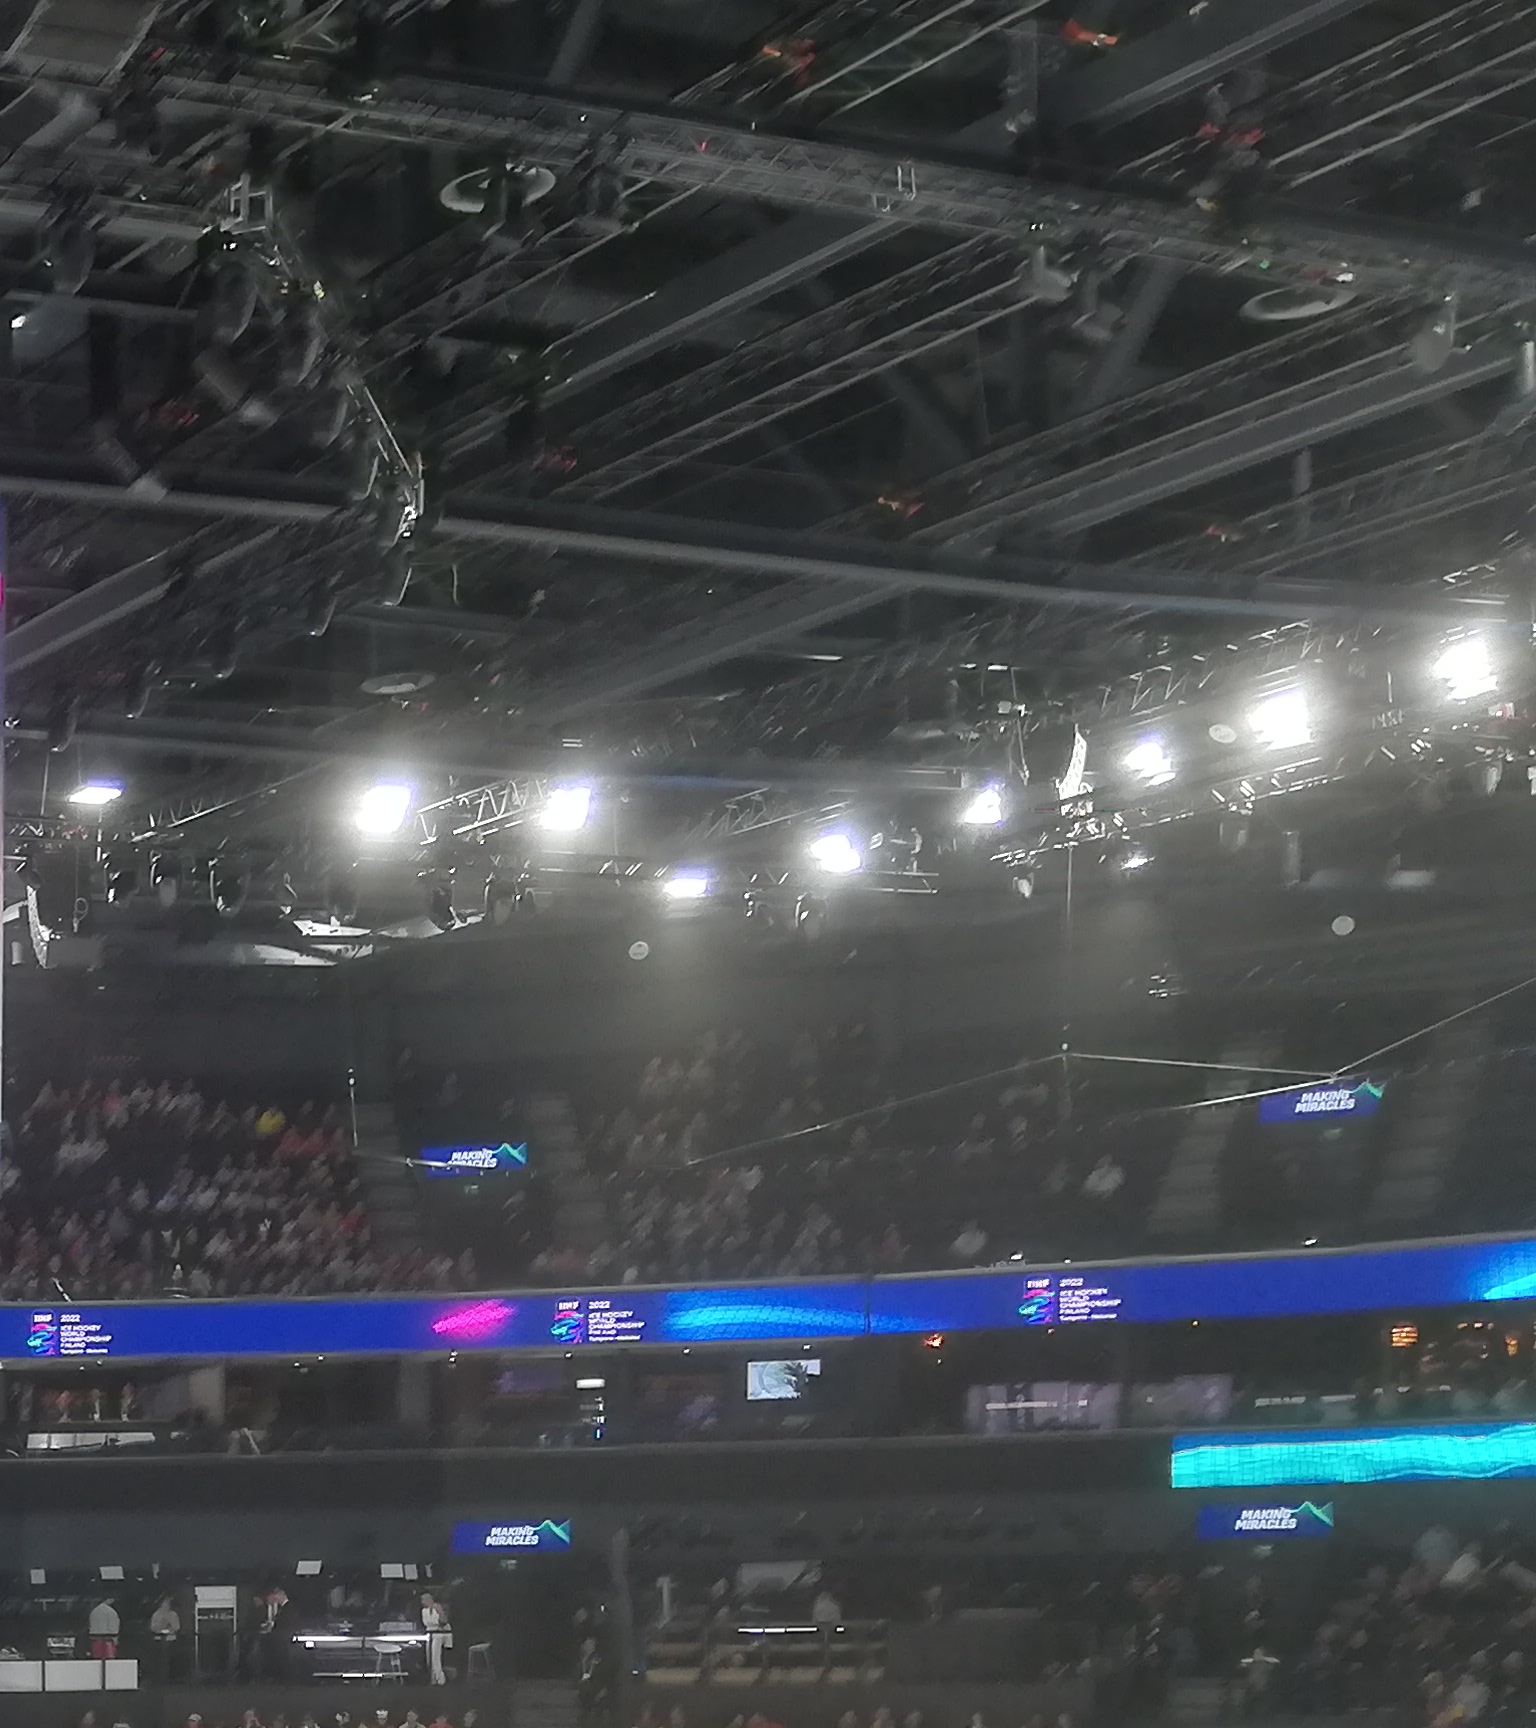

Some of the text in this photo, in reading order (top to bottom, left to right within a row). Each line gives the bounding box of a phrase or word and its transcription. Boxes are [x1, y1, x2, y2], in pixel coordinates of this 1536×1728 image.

[451, 1149, 493, 1161] MAKING
[490, 1526, 534, 1537] MAKING
[485, 1535, 539, 1546] MIRACLES
